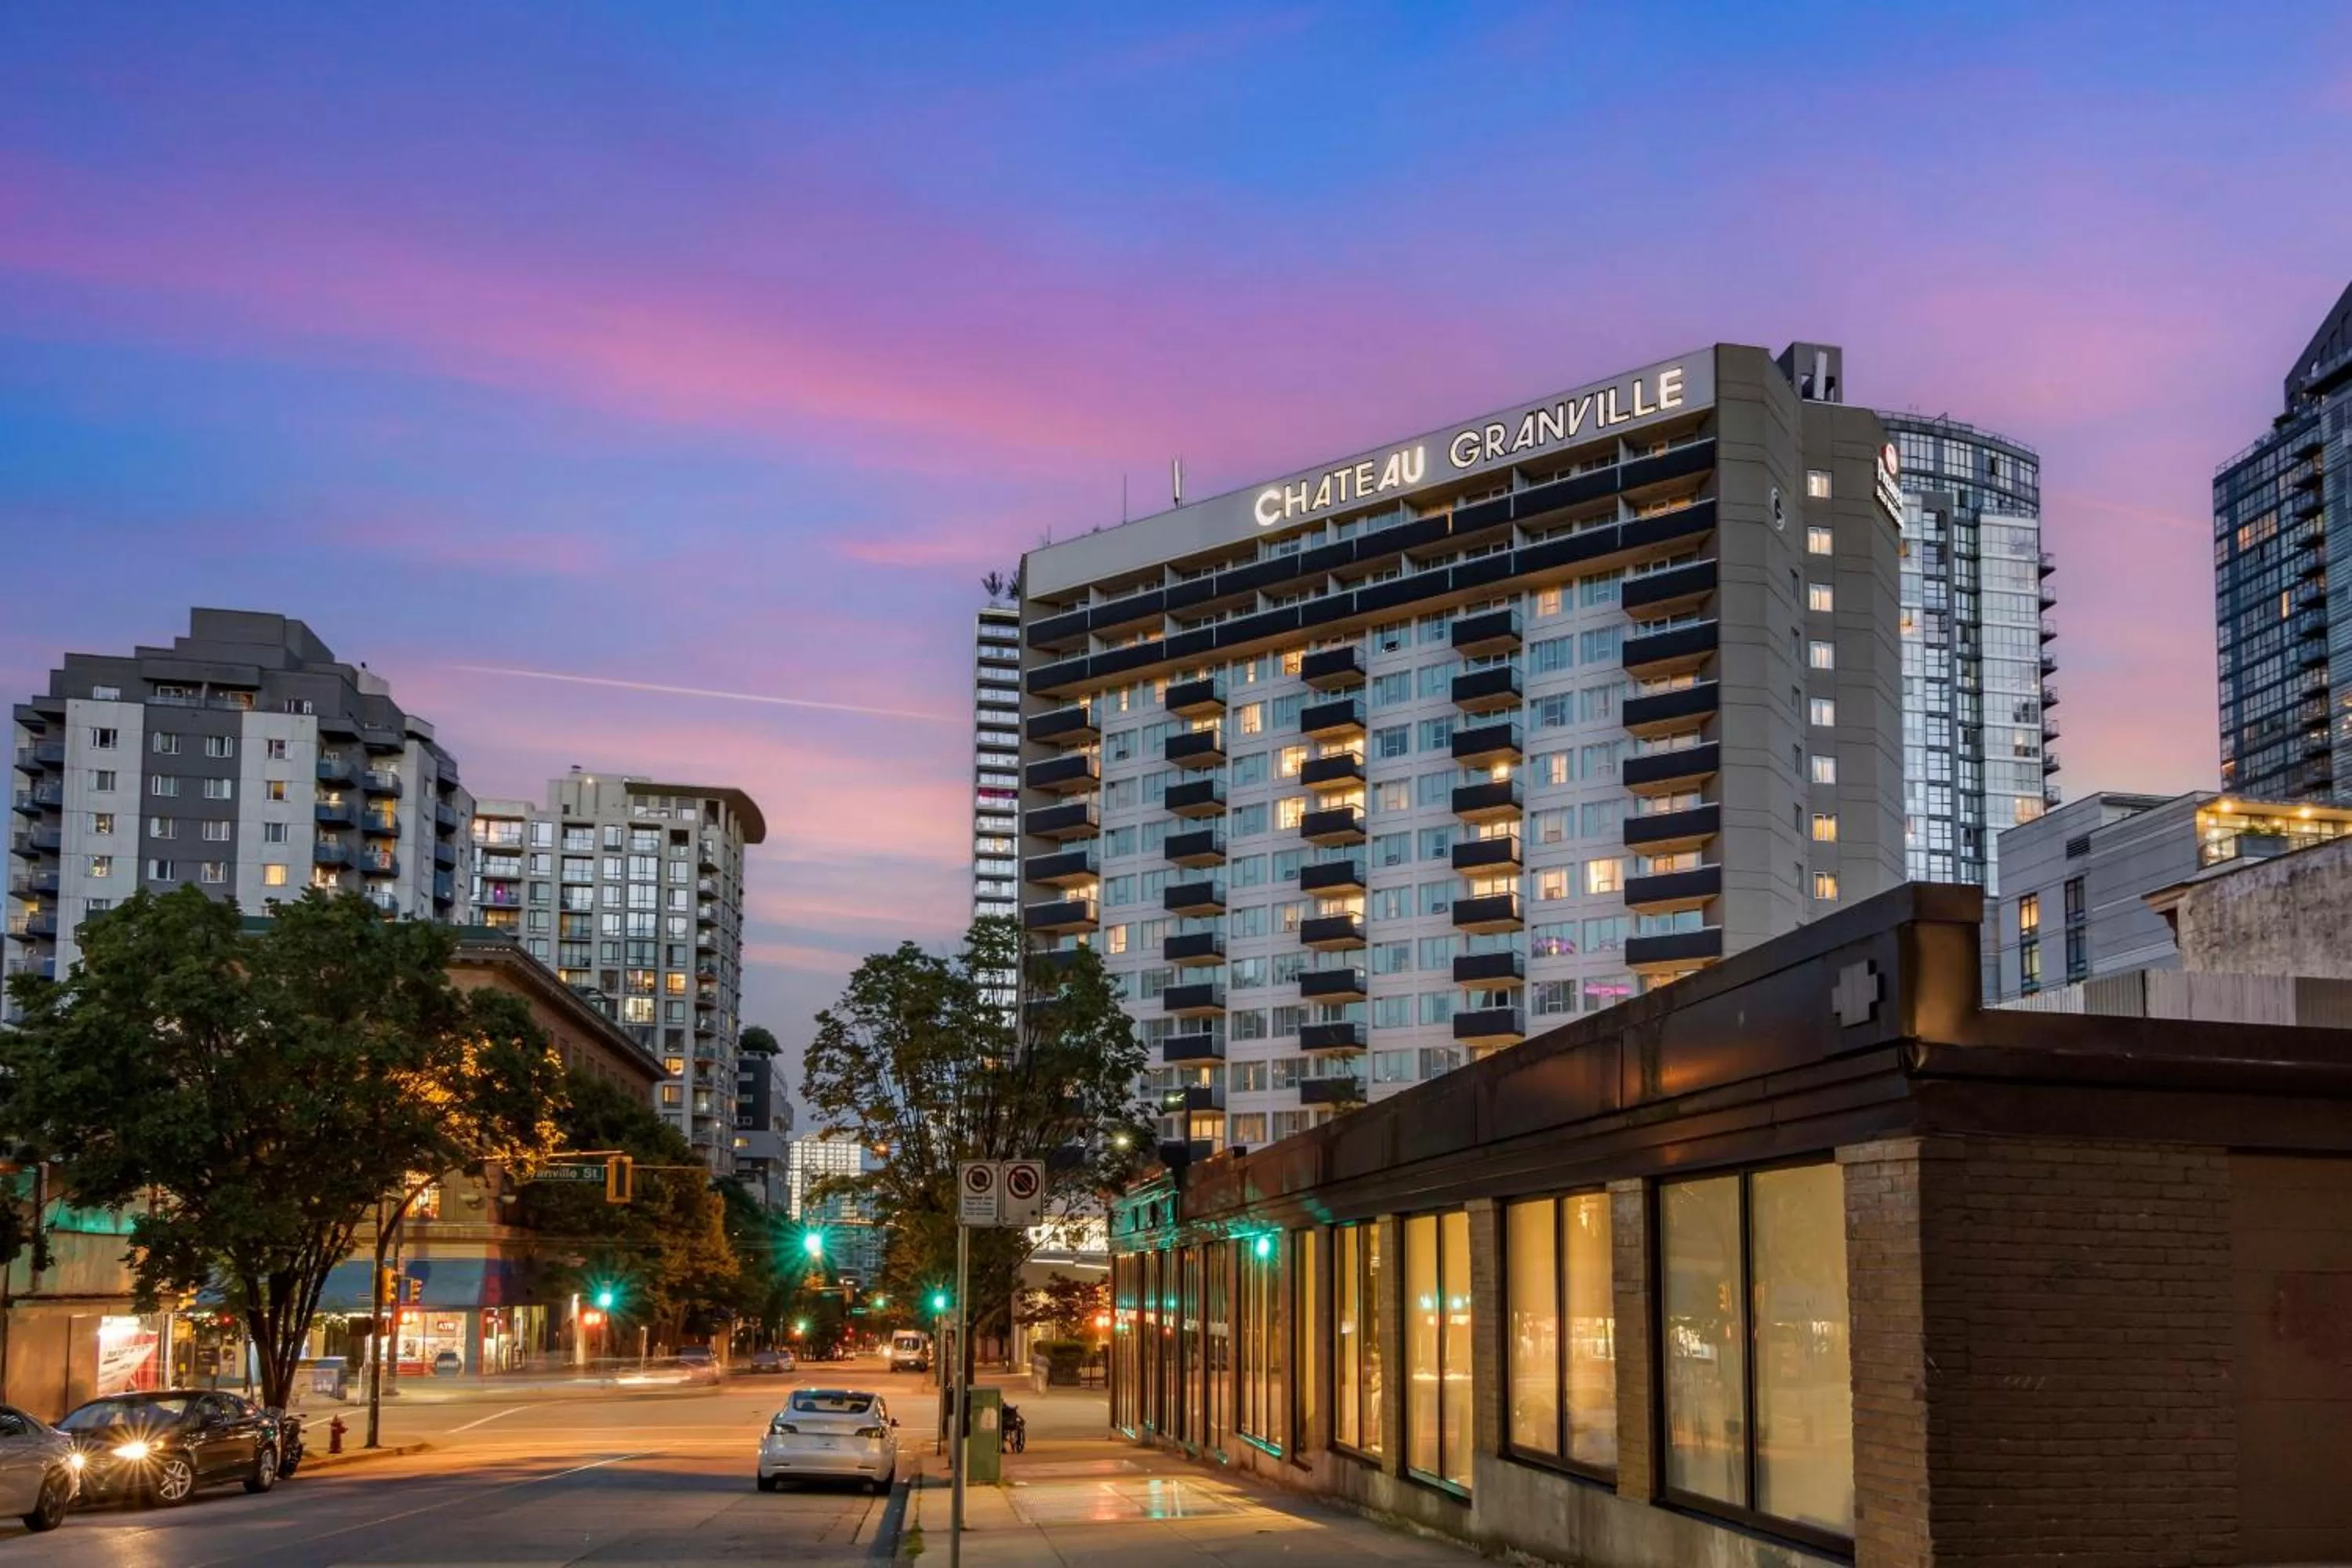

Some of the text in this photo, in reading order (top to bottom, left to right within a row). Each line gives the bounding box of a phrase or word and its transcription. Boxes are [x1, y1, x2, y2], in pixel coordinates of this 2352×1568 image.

[1254, 366, 1684, 526] CHATEAU GRANVILLE
[535, 1167, 598, 1178] anville St
[438, 1322, 455, 1330] ATM
